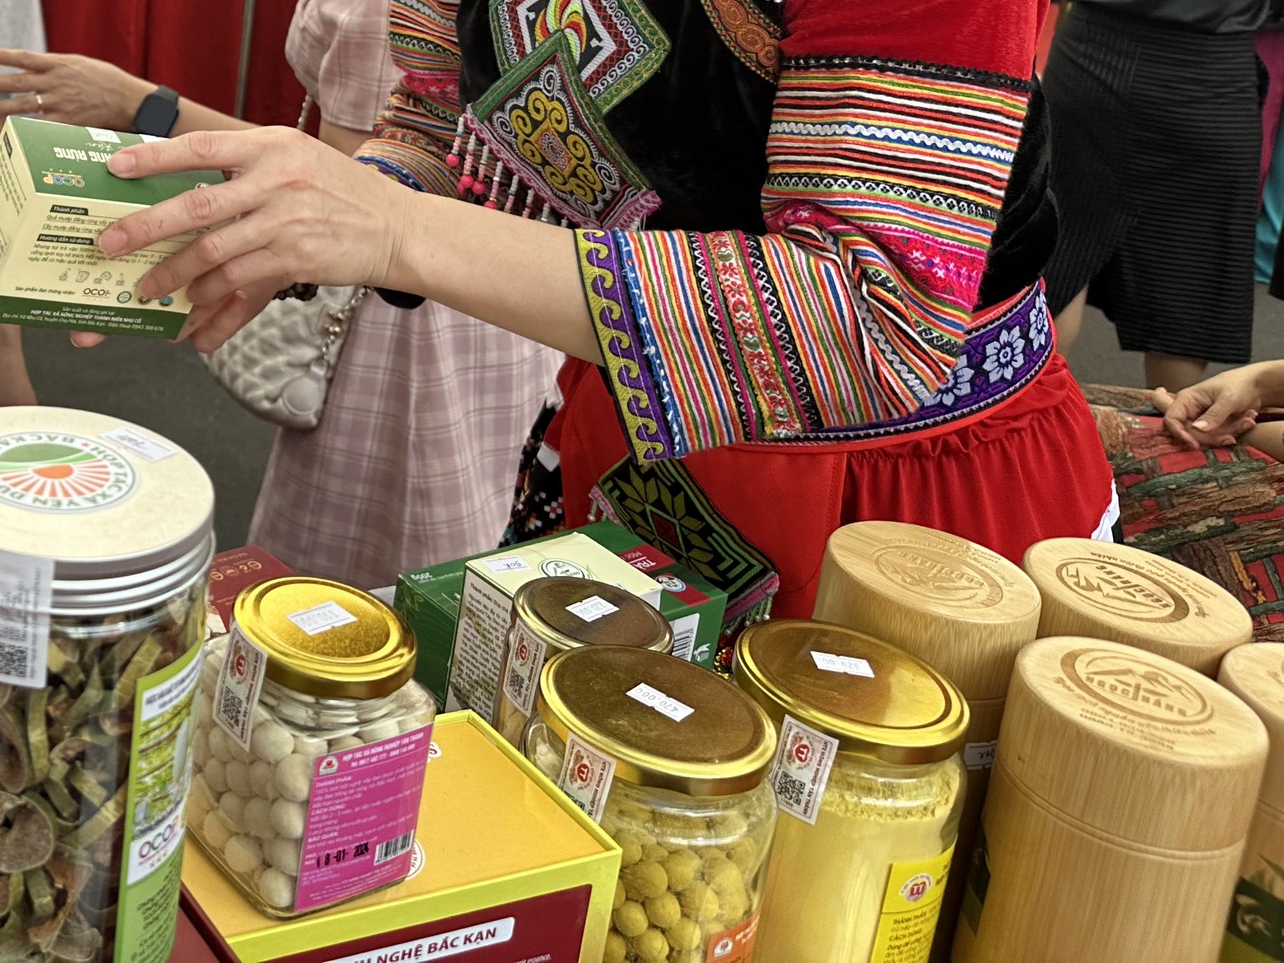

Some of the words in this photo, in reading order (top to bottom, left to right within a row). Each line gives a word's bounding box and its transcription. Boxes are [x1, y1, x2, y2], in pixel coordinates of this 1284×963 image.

[375, 943, 423, 960] NGHỆ
[427, 935, 460, 955] BẮC
[463, 927, 497, 945] KẠN
